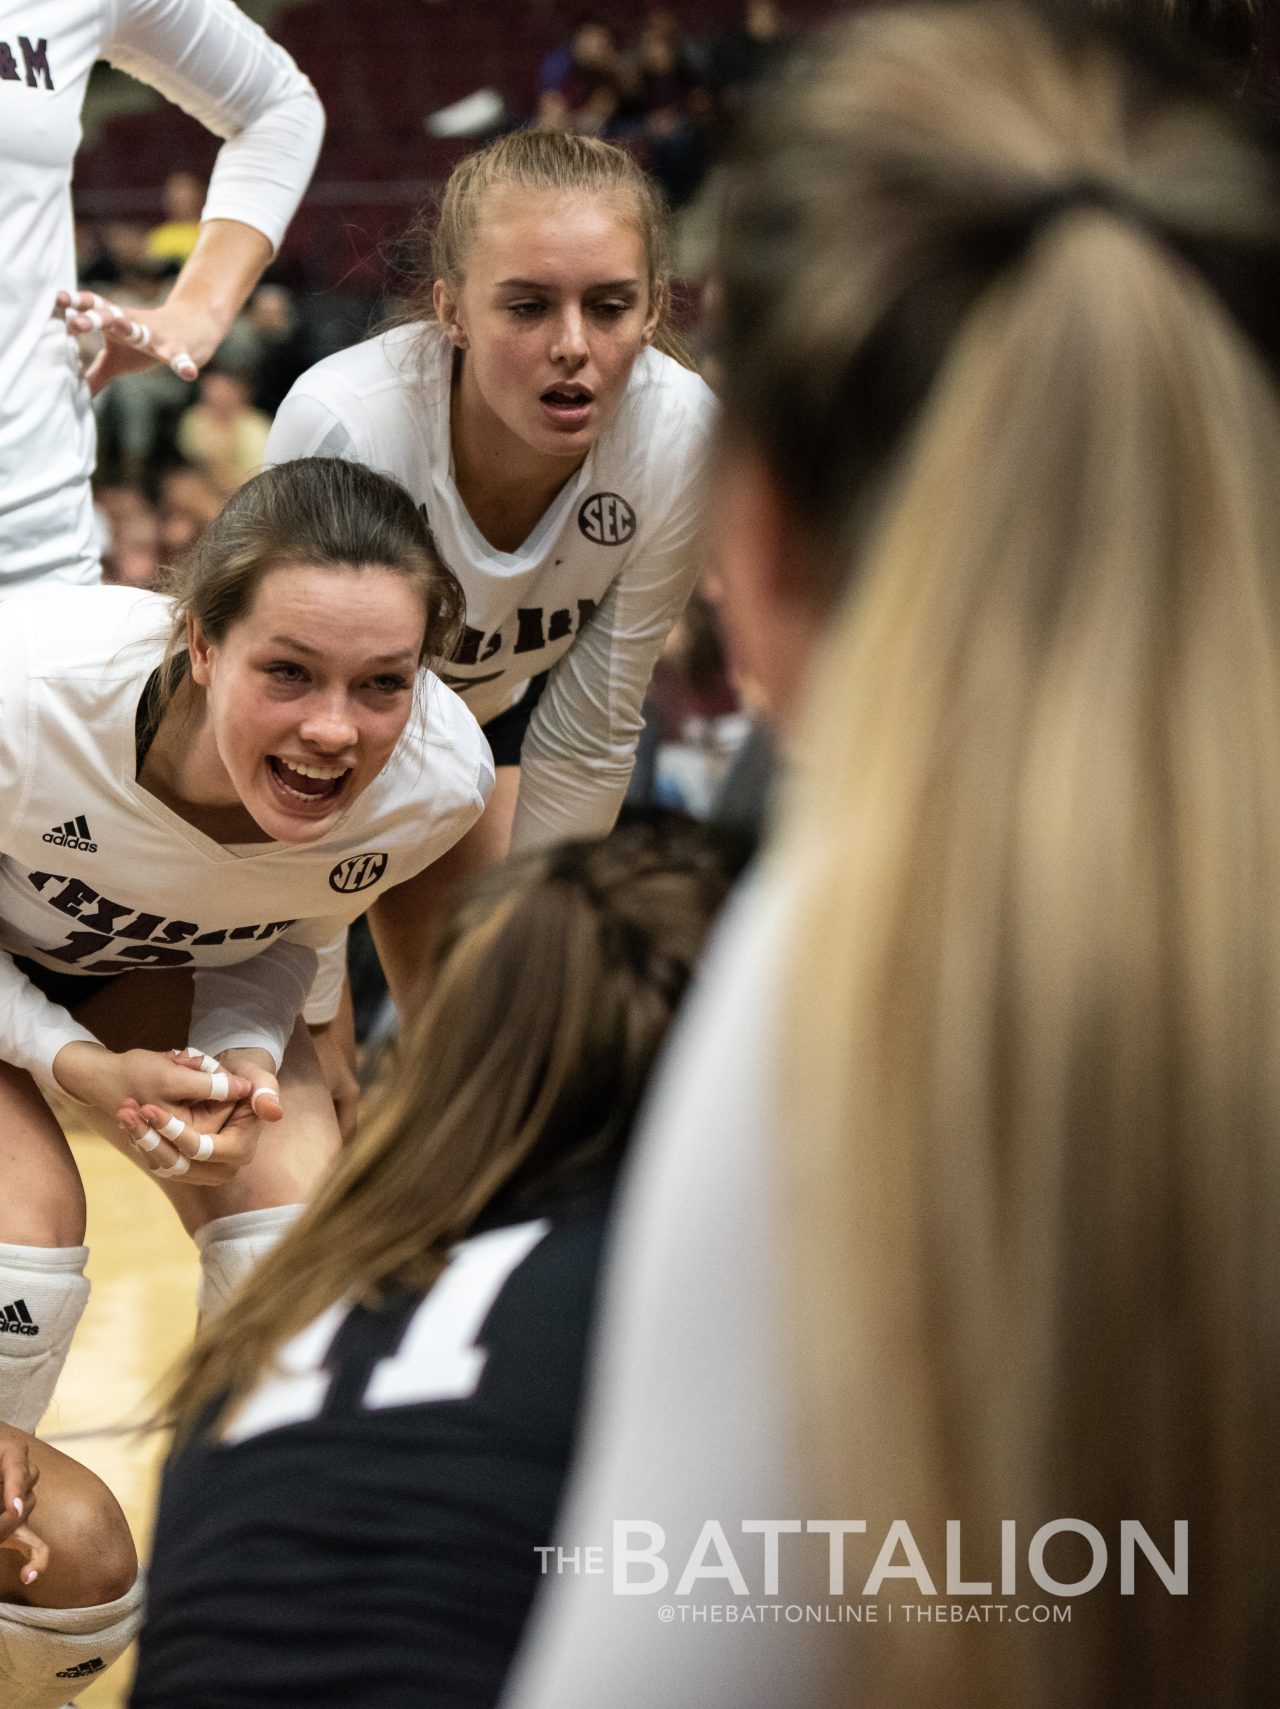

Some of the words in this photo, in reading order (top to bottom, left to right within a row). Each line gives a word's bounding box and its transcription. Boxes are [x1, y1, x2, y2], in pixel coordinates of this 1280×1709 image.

[582, 494, 633, 542] SEC
[42, 831, 98, 853] adidas
[334, 855, 385, 890] SEC
[28, 871, 199, 945] TEXAS
